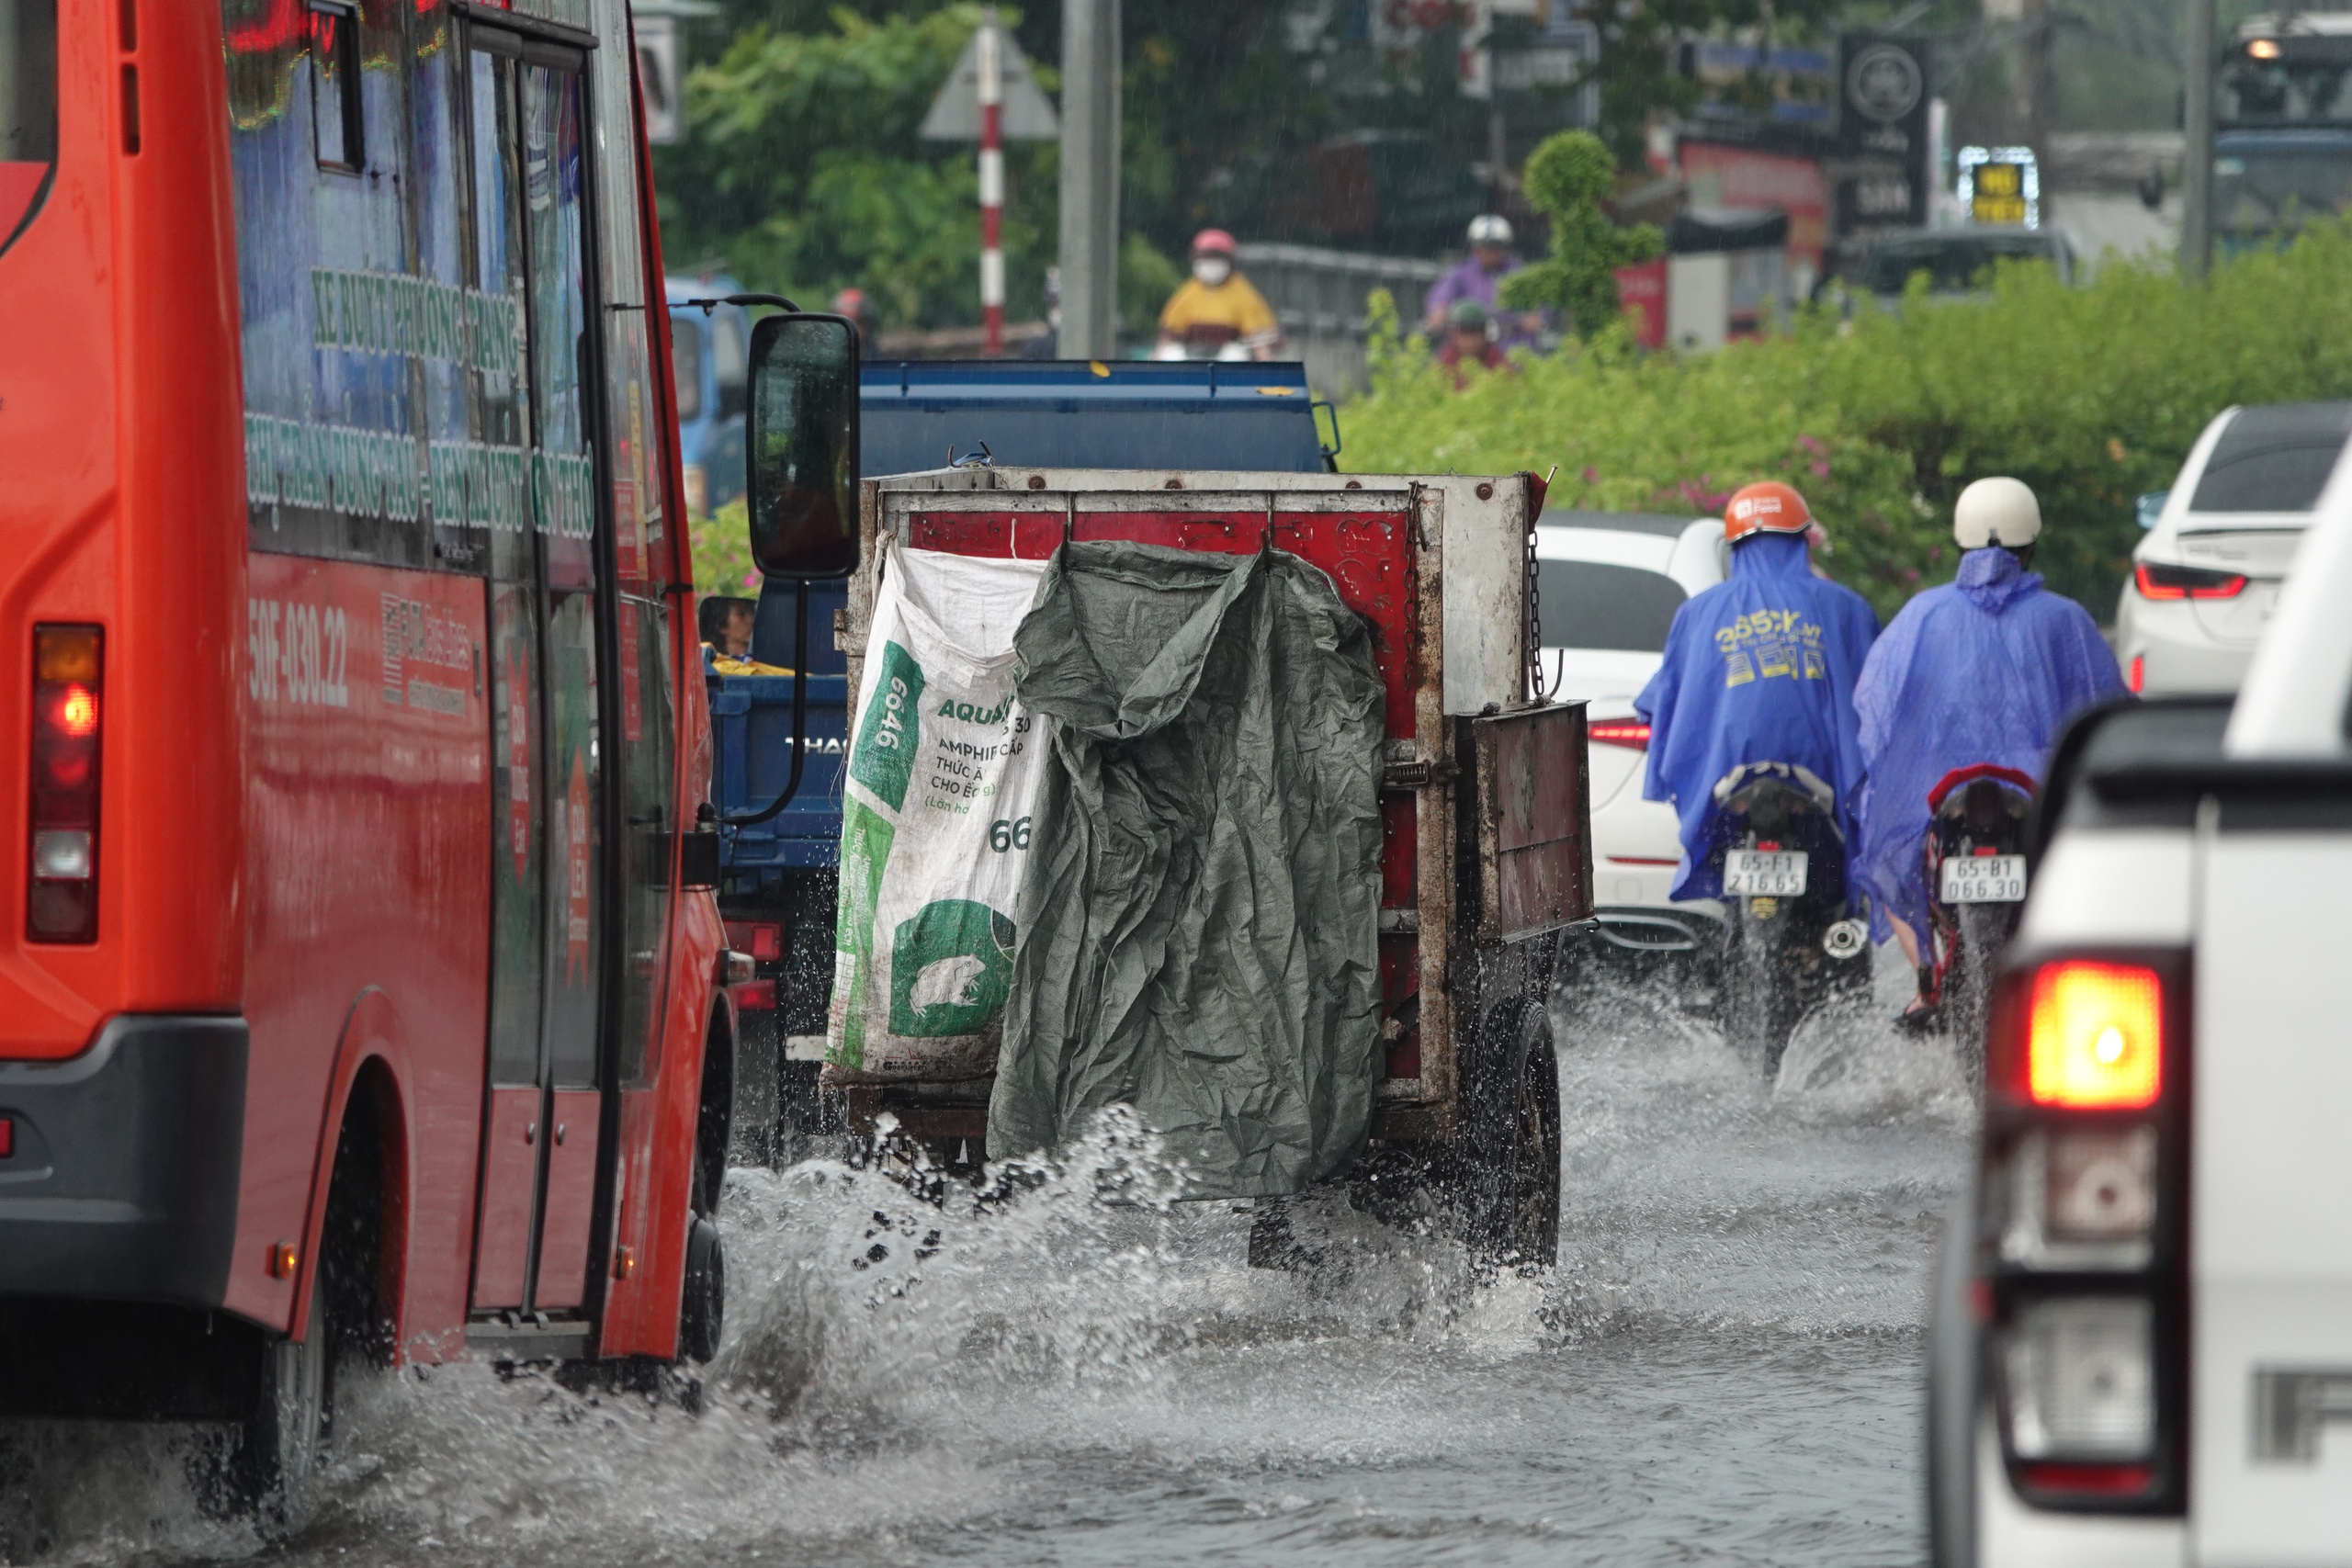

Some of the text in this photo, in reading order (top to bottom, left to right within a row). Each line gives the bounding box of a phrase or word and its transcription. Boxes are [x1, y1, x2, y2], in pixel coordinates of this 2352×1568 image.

[311, 265, 339, 351] XE
[465, 284, 518, 378] TANG
[488, 410, 524, 534] UÝT
[557, 439, 596, 542] THƠ
[876, 676, 908, 750] 6646
[936, 756, 971, 779] THỨC
[931, 775, 960, 795] CHO
[924, 795, 952, 813] (Lớn
[1728, 874, 1800, 894] 216.65
[1949, 879, 2020, 899] 066.30
